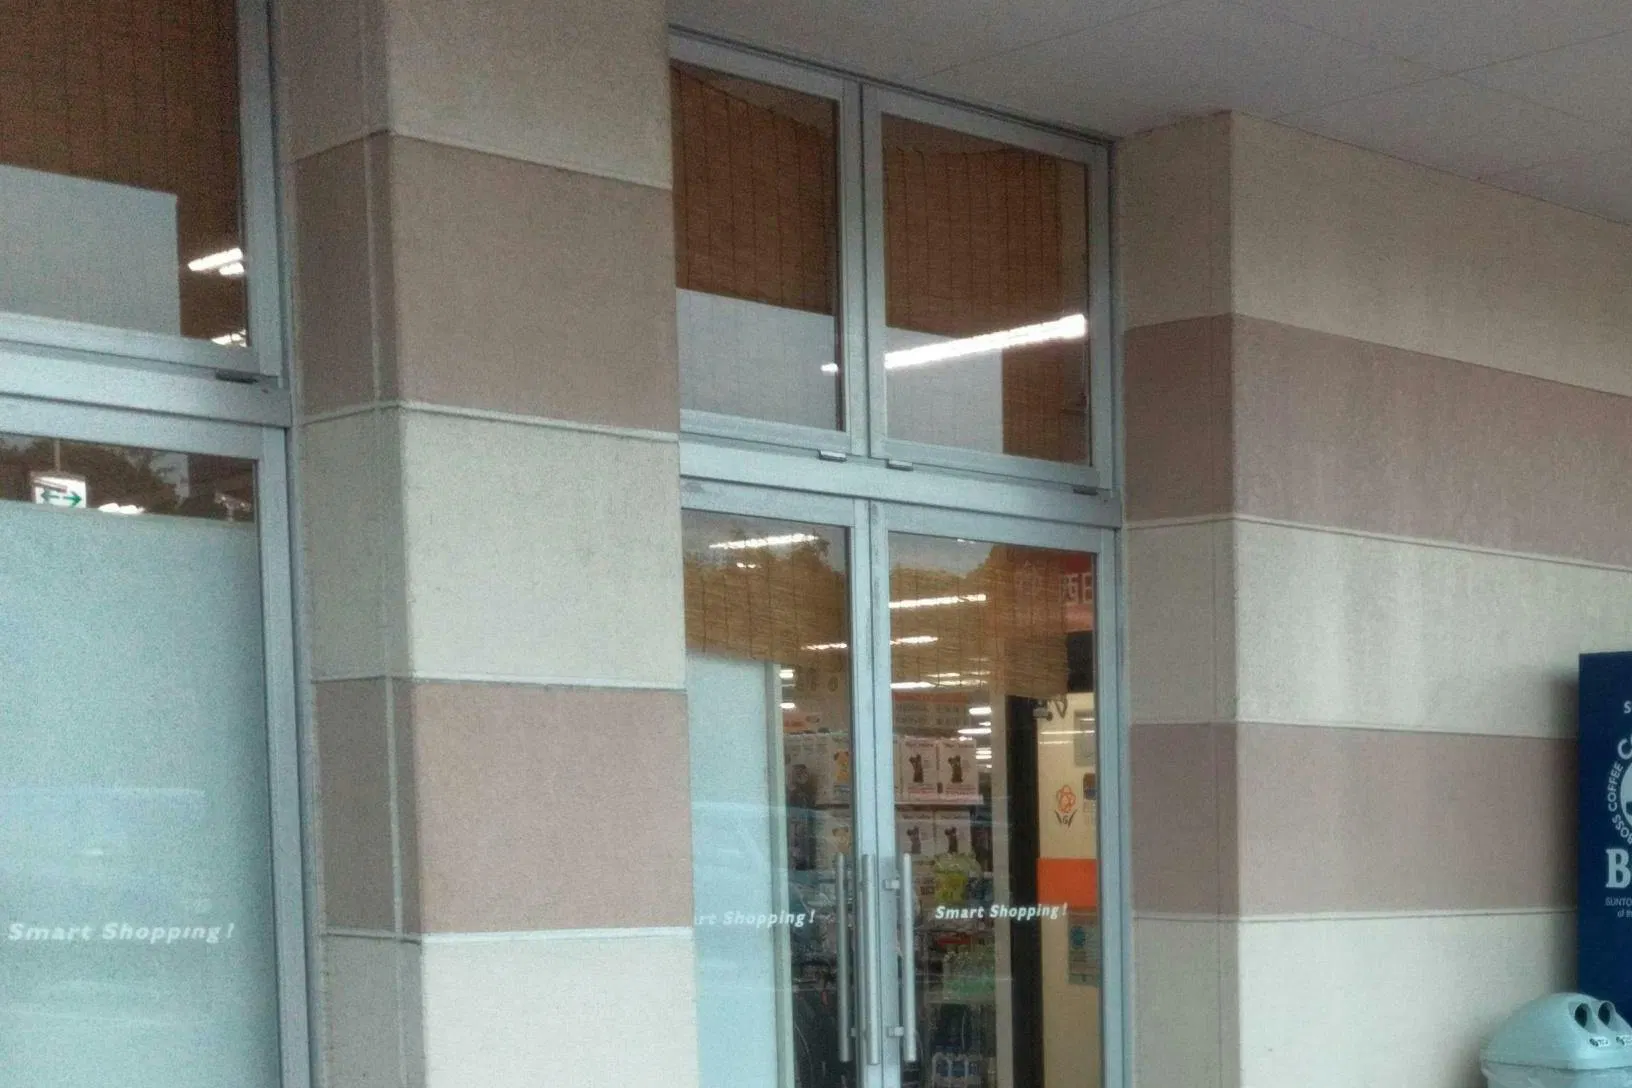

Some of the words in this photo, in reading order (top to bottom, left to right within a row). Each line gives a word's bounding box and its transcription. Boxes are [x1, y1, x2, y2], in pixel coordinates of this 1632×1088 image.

[1607, 761, 1624, 812] COFFEE
[935, 905, 985, 919] Smart
[1617, 909, 1624, 919] of
[8, 923, 93, 941] Smart
